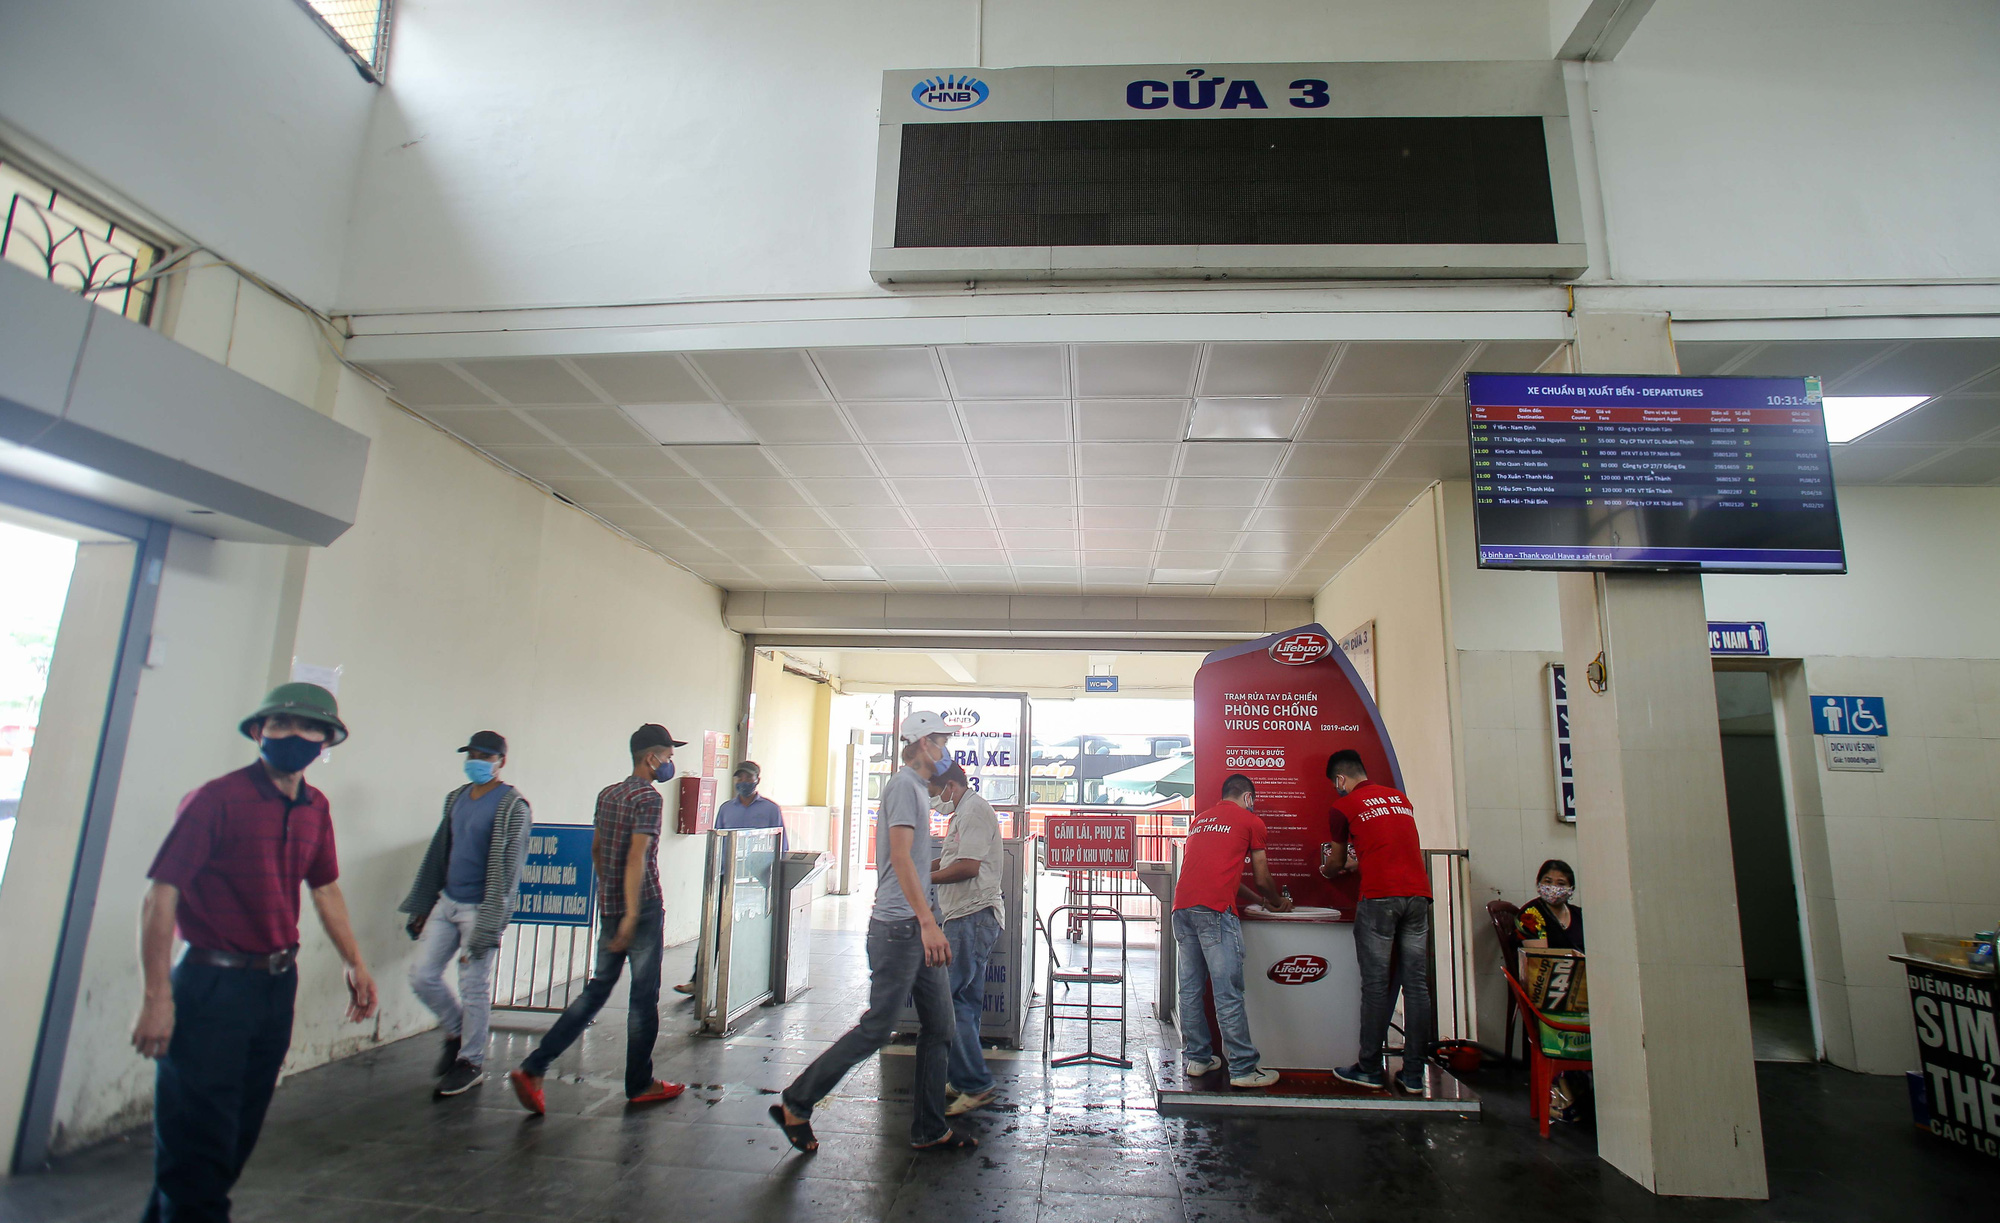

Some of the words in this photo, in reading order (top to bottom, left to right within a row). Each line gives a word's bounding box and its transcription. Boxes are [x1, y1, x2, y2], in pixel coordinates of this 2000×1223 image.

[928, 92, 971, 102] HNB
[1126, 68, 1268, 109] CỬA
[1289, 79, 1330, 108] 3
[1528, 387, 1539, 395] XE
[1542, 384, 1574, 395] CHUẨN
[1577, 388, 1586, 397] BỊ
[1588, 385, 1613, 396] XUẤT
[1616, 386, 1635, 396] BẾN
[1643, 388, 1703, 397] DEPARTURES
[1541, 552, 1556, 560] you!
[1598, 553, 1612, 561] trip!
[1364, 631, 1368, 643] 3
[1722, 631, 1748, 649] NAM
[1277, 643, 1325, 654] Lifebuoy
[1224, 693, 1245, 701] TRẠM
[1248, 691, 1264, 700] RỬA
[1294, 691, 1317, 701] CHIẾN
[1225, 702, 1269, 716] PHÒNG
[1273, 701, 1318, 716] CHỐNG
[1224, 720, 1259, 730] VIRUS
[1262, 720, 1312, 731] CORONA
[1862, 743, 1875, 752] SINH
[955, 750, 979, 766] RA
[986, 751, 1010, 767] XE
[969, 777, 980, 792] 3
[1054, 821, 1074, 839] CẤM
[1076, 822, 1092, 841] LÁI,
[1094, 826, 1112, 842] PHỤ
[1114, 826, 1125, 839] XE
[528, 836, 543, 854] KHU
[544, 836, 558, 859] VỰC
[1051, 849, 1060, 865] TỤ
[1061, 846, 1075, 865] TẬP
[1077, 844, 1081, 862] Ở
[1083, 849, 1097, 862] KHU
[1099, 847, 1113, 865] VỰC
[1115, 846, 1129, 862] NÀY
[542, 862, 561, 885] HÀNG
[562, 862, 577, 885] HÓA
[522, 894, 533, 912] XE
[533, 891, 542, 913] VÀ
[543, 891, 563, 914] HÀNH
[563, 892, 587, 915] KHÁCH
[1275, 965, 1324, 975] Lifebuoy
[1908, 973, 1952, 997] ĐIỂM
[1952, 983, 1992, 1007] BÁN
[995, 992, 1004, 1012] VÉ
[1914, 995, 2000, 1066] SIM
[1925, 1063, 2000, 1137] THẺ
[1930, 1119, 1968, 1145] CÁC
